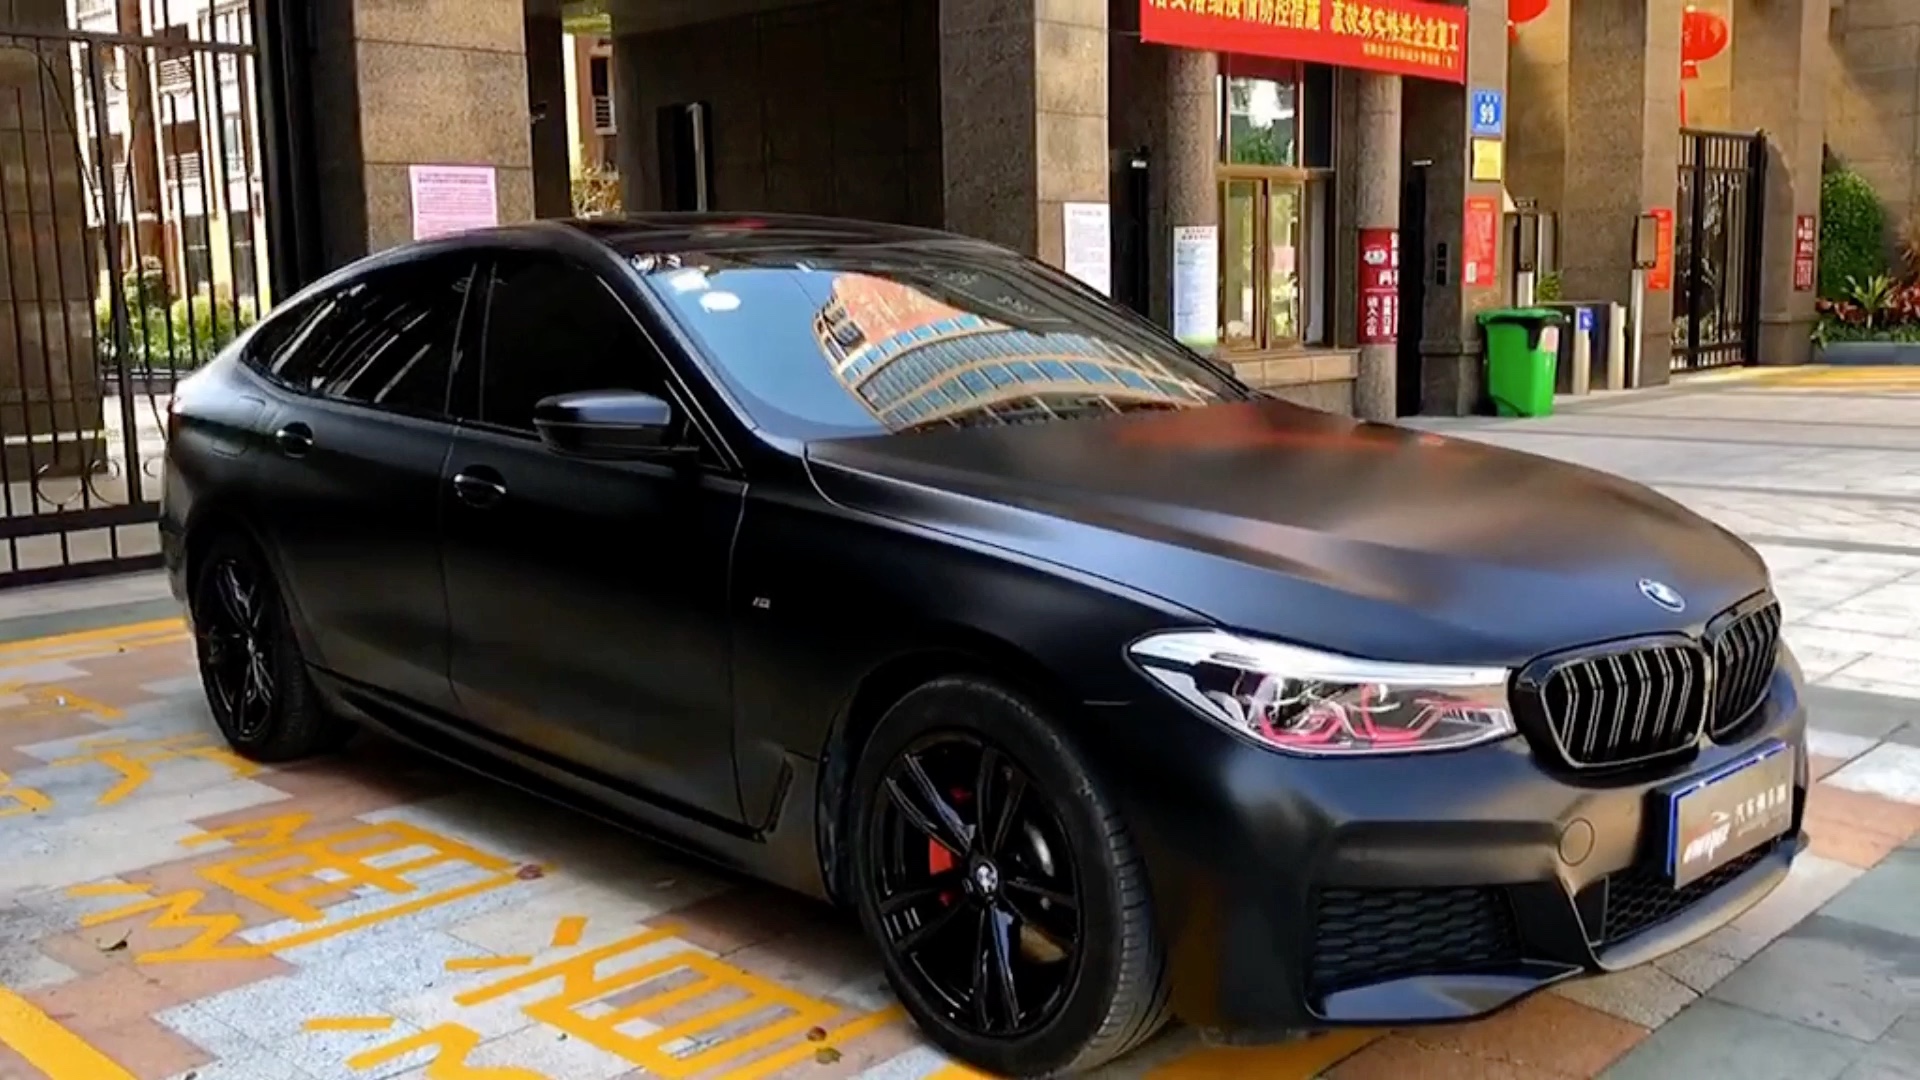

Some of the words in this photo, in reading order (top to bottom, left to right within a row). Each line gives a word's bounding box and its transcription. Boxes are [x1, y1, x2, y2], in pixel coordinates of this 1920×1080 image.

[1148, 0, 1321, 30] 疫情防控措施
[1480, 103, 1496, 124] 99
